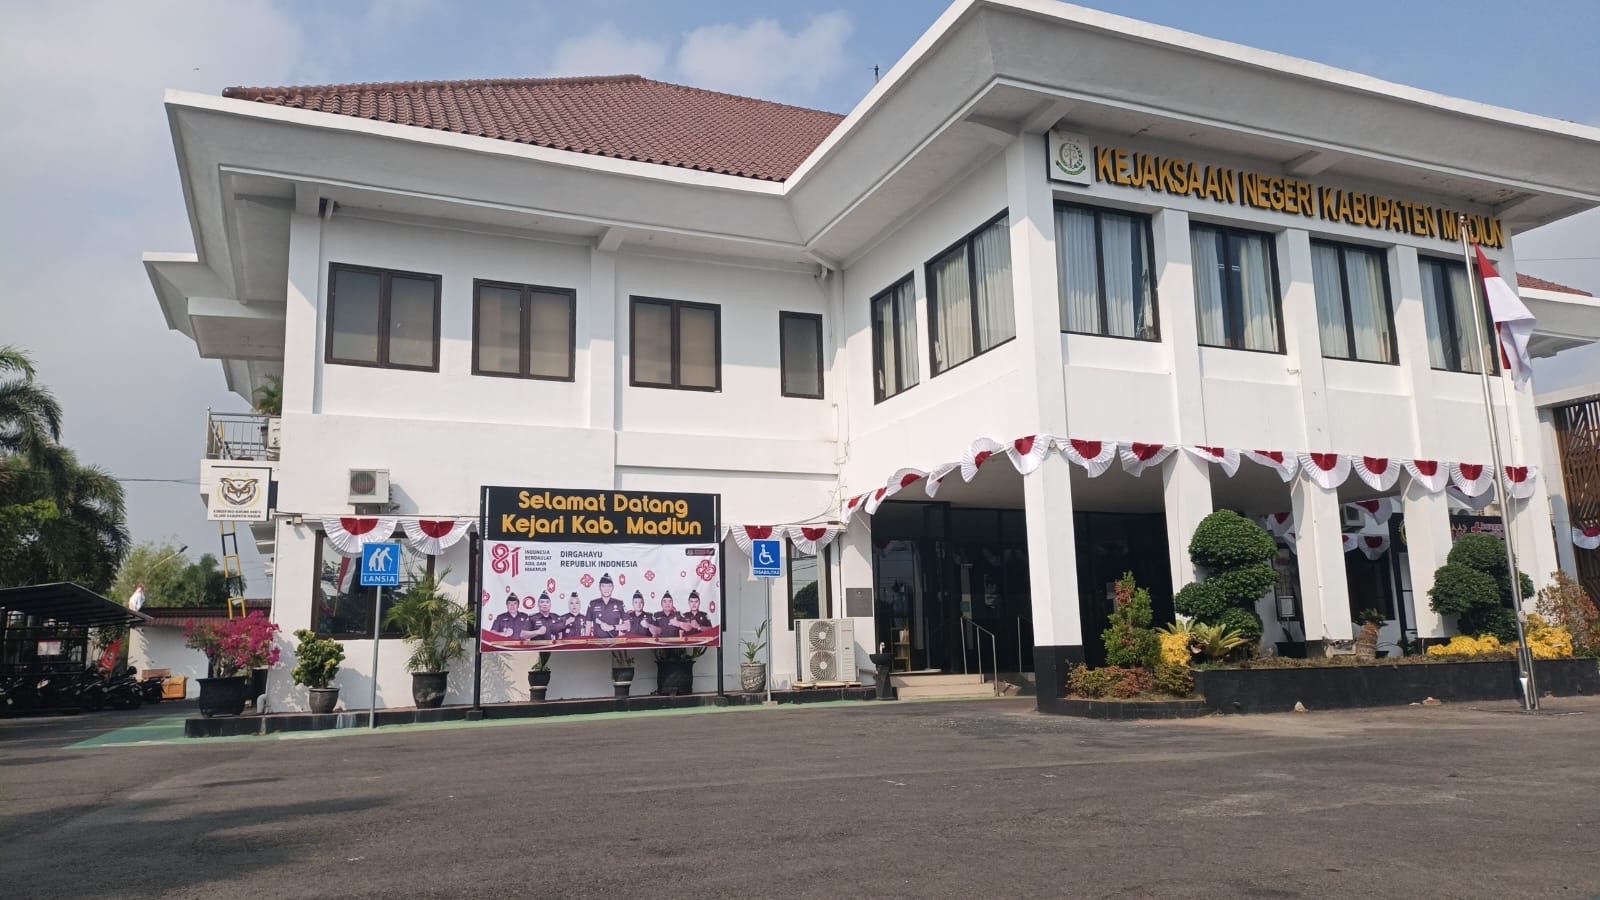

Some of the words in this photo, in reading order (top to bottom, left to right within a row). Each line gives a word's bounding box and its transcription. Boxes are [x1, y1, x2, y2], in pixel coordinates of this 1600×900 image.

[1094, 144, 1237, 203] KEJAKSAAN
[1239, 171, 1316, 217] NEGERI
[1318, 185, 1437, 238] KABUPATEN
[518, 490, 606, 511] Selamat
[614, 493, 689, 519] Datang
[502, 513, 564, 538] Kejari
[572, 515, 619, 535] Kab.
[626, 516, 702, 536] Madiun
[491, 543, 522, 578] 81
[560, 550, 603, 558] DIRGAHAYU
[560, 560, 597, 568] REPUBLIK
[598, 560, 638, 568] INDONESIA
[363, 575, 396, 583] LANSIA
